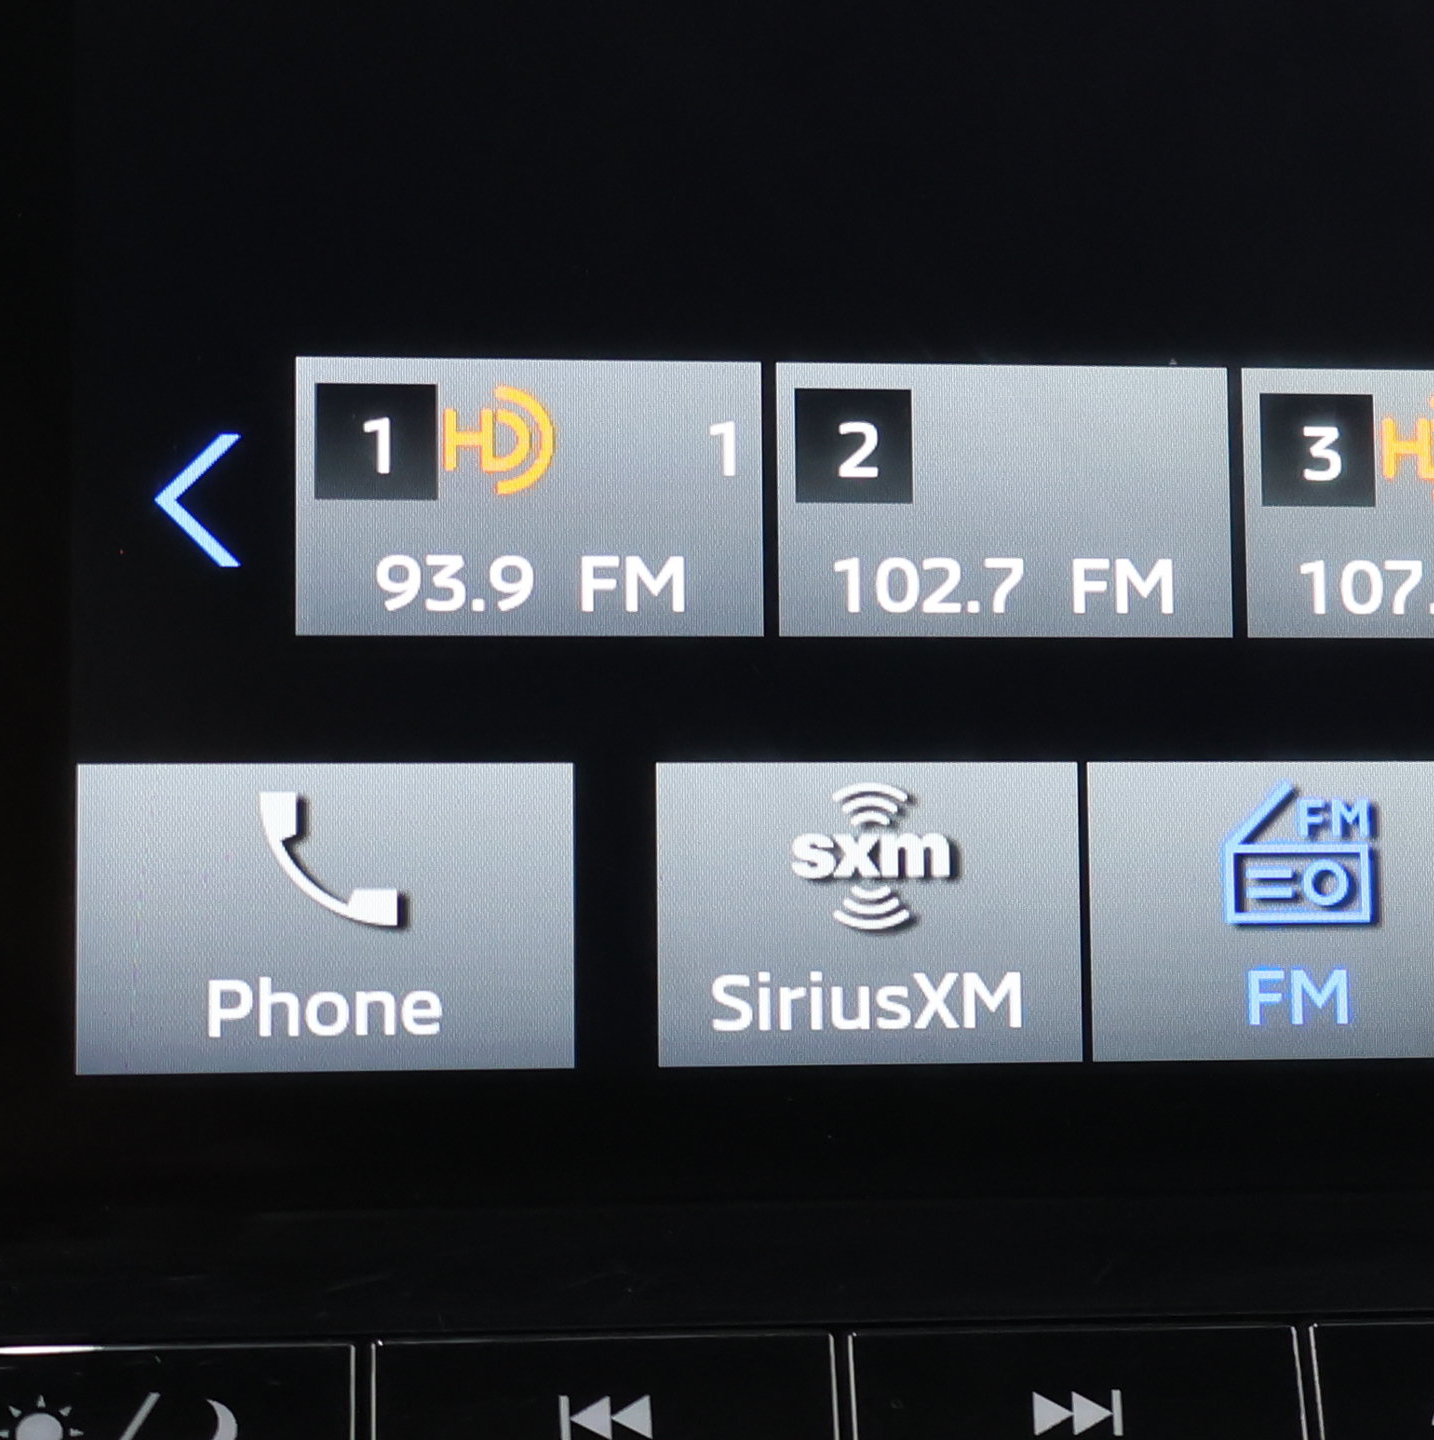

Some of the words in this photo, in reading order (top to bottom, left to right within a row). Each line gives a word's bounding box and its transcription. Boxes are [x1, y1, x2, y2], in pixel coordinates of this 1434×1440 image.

[363, 417, 391, 474] 1
[709, 420, 736, 477] 1
[837, 421, 879, 478] 2
[1301, 425, 1342, 482] 3
[375, 554, 536, 613] 93.9
[580, 555, 686, 613] FM
[833, 557, 1025, 614] 102.7
[1071, 558, 1173, 615] FM
[1296, 797, 1372, 838] FM
[791, 831, 951, 881] sxm
[207, 976, 444, 1039] Phone
[710, 971, 1023, 1033] SiriusXM
[1247, 968, 1350, 1026] FM
